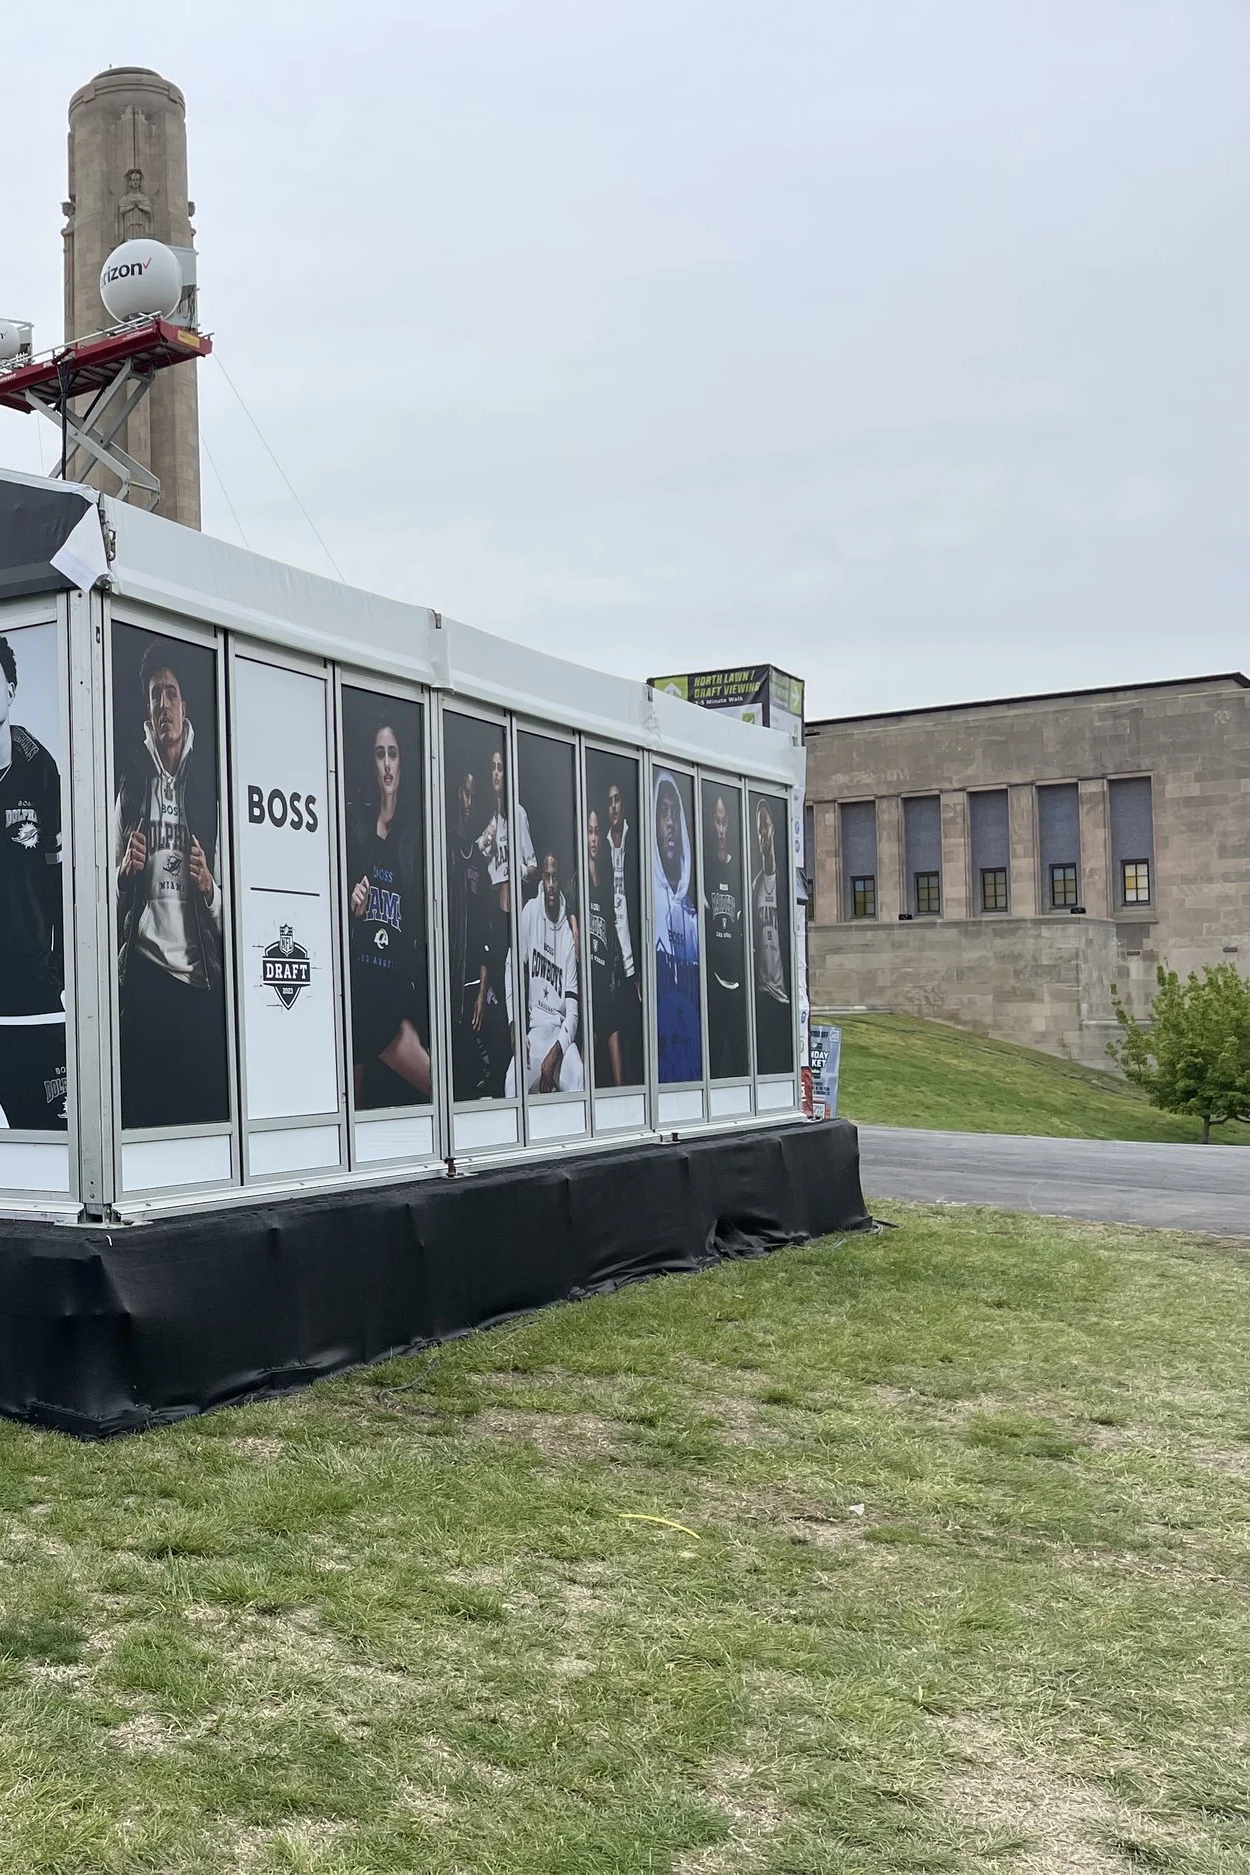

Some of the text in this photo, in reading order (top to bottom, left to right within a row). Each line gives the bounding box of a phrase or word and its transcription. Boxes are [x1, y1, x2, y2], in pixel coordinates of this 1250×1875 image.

[101, 262, 143, 288] rizon
[694, 674, 723, 687] NORTH
[724, 671, 749, 684] LAWN
[694, 682, 761, 699] DRAFT VIEWING
[248, 785, 318, 833] BOSS
[266, 963, 307, 979] DRAFT
[811, 1060, 827, 1068] KET
